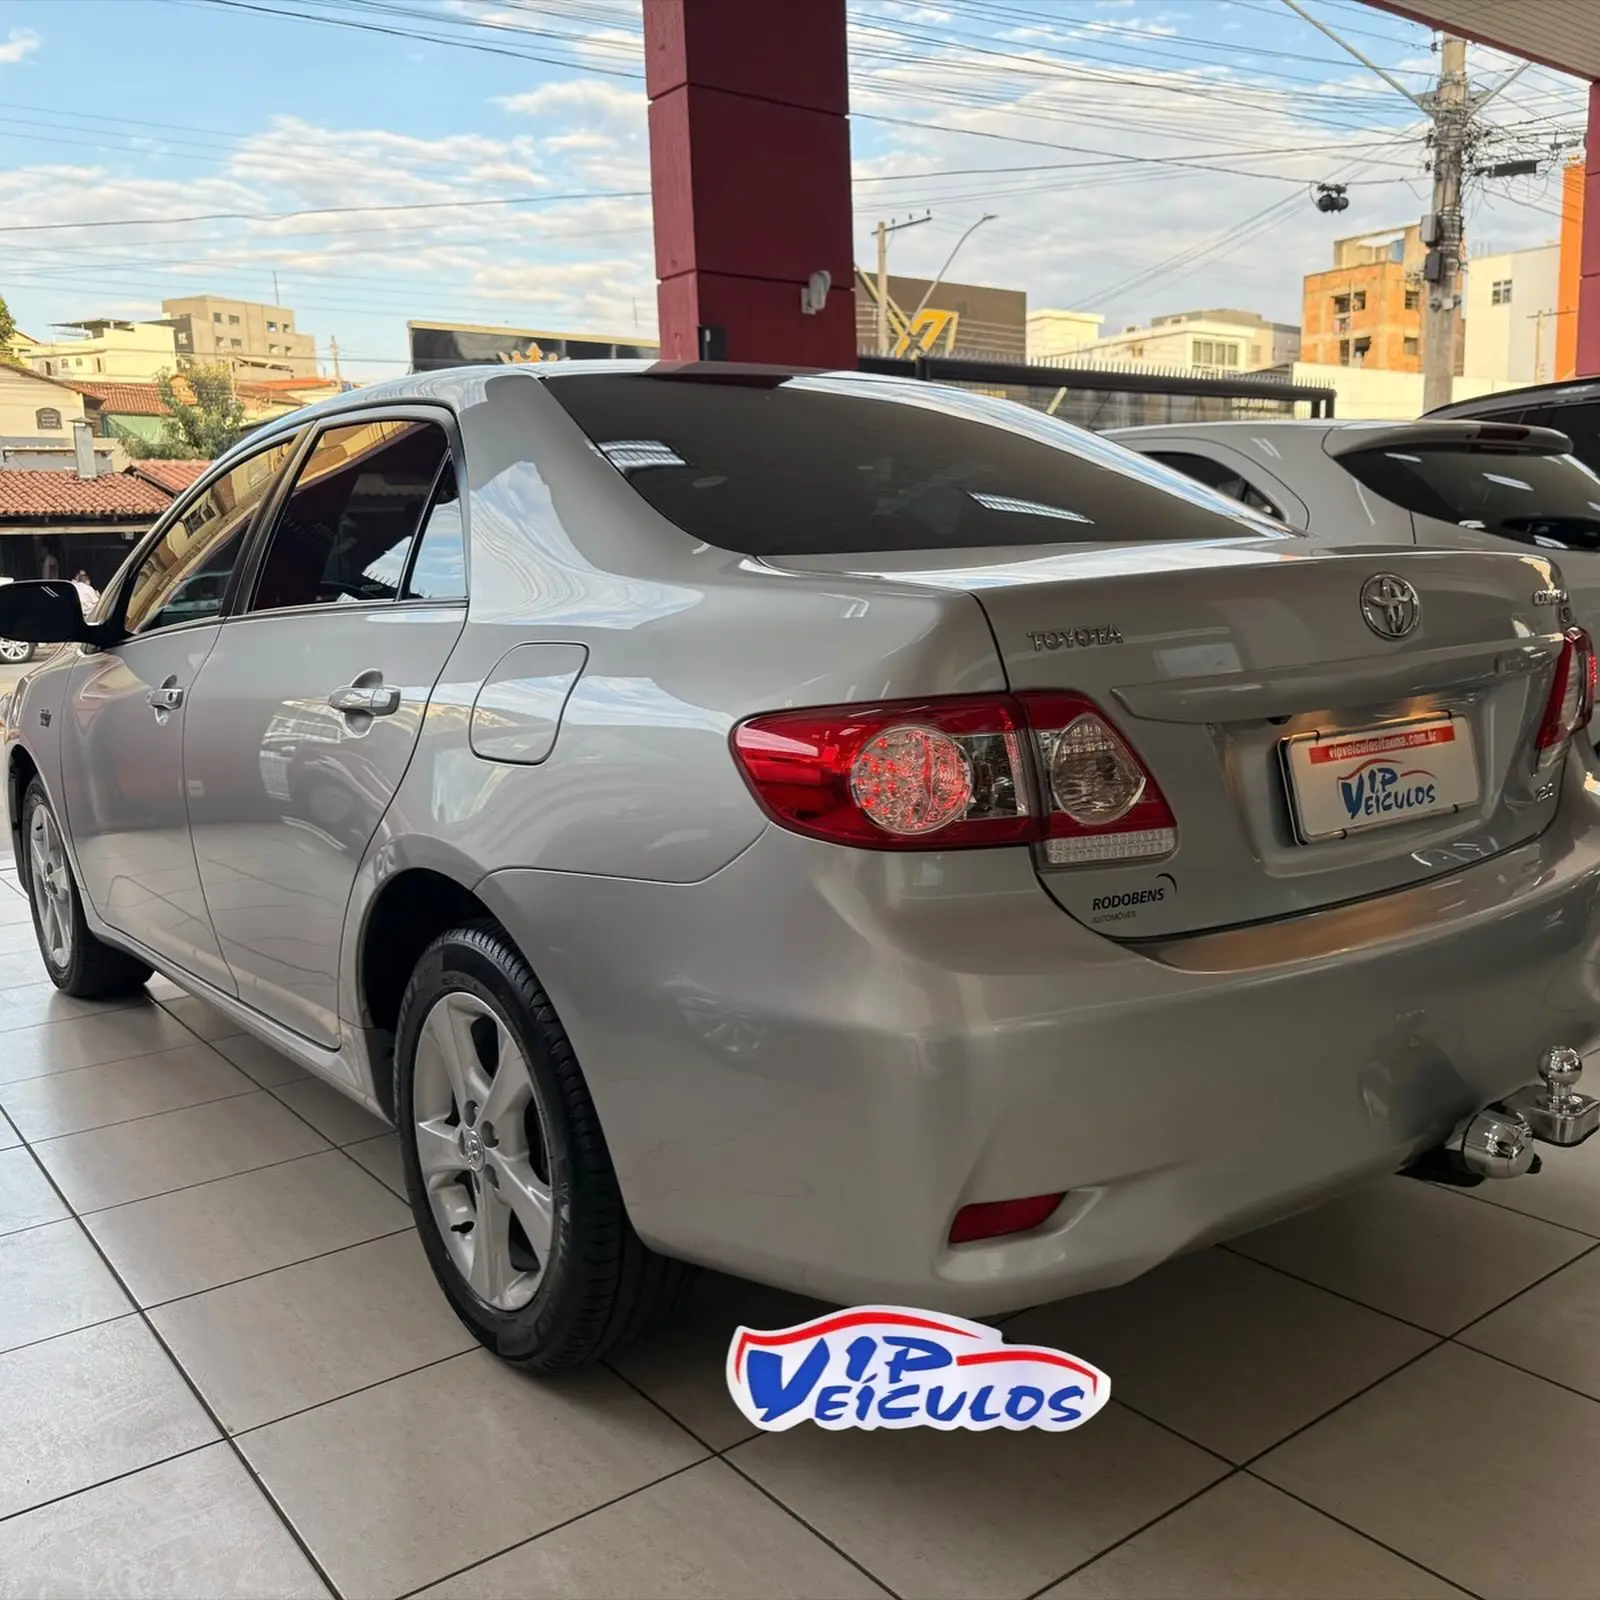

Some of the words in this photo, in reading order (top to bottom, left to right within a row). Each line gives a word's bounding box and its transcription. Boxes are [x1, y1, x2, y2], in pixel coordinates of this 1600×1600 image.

[1026, 623, 1125, 652] TOYOTA
[1341, 767, 1398, 820] VIP
[1092, 887, 1165, 911] RODOBENS
